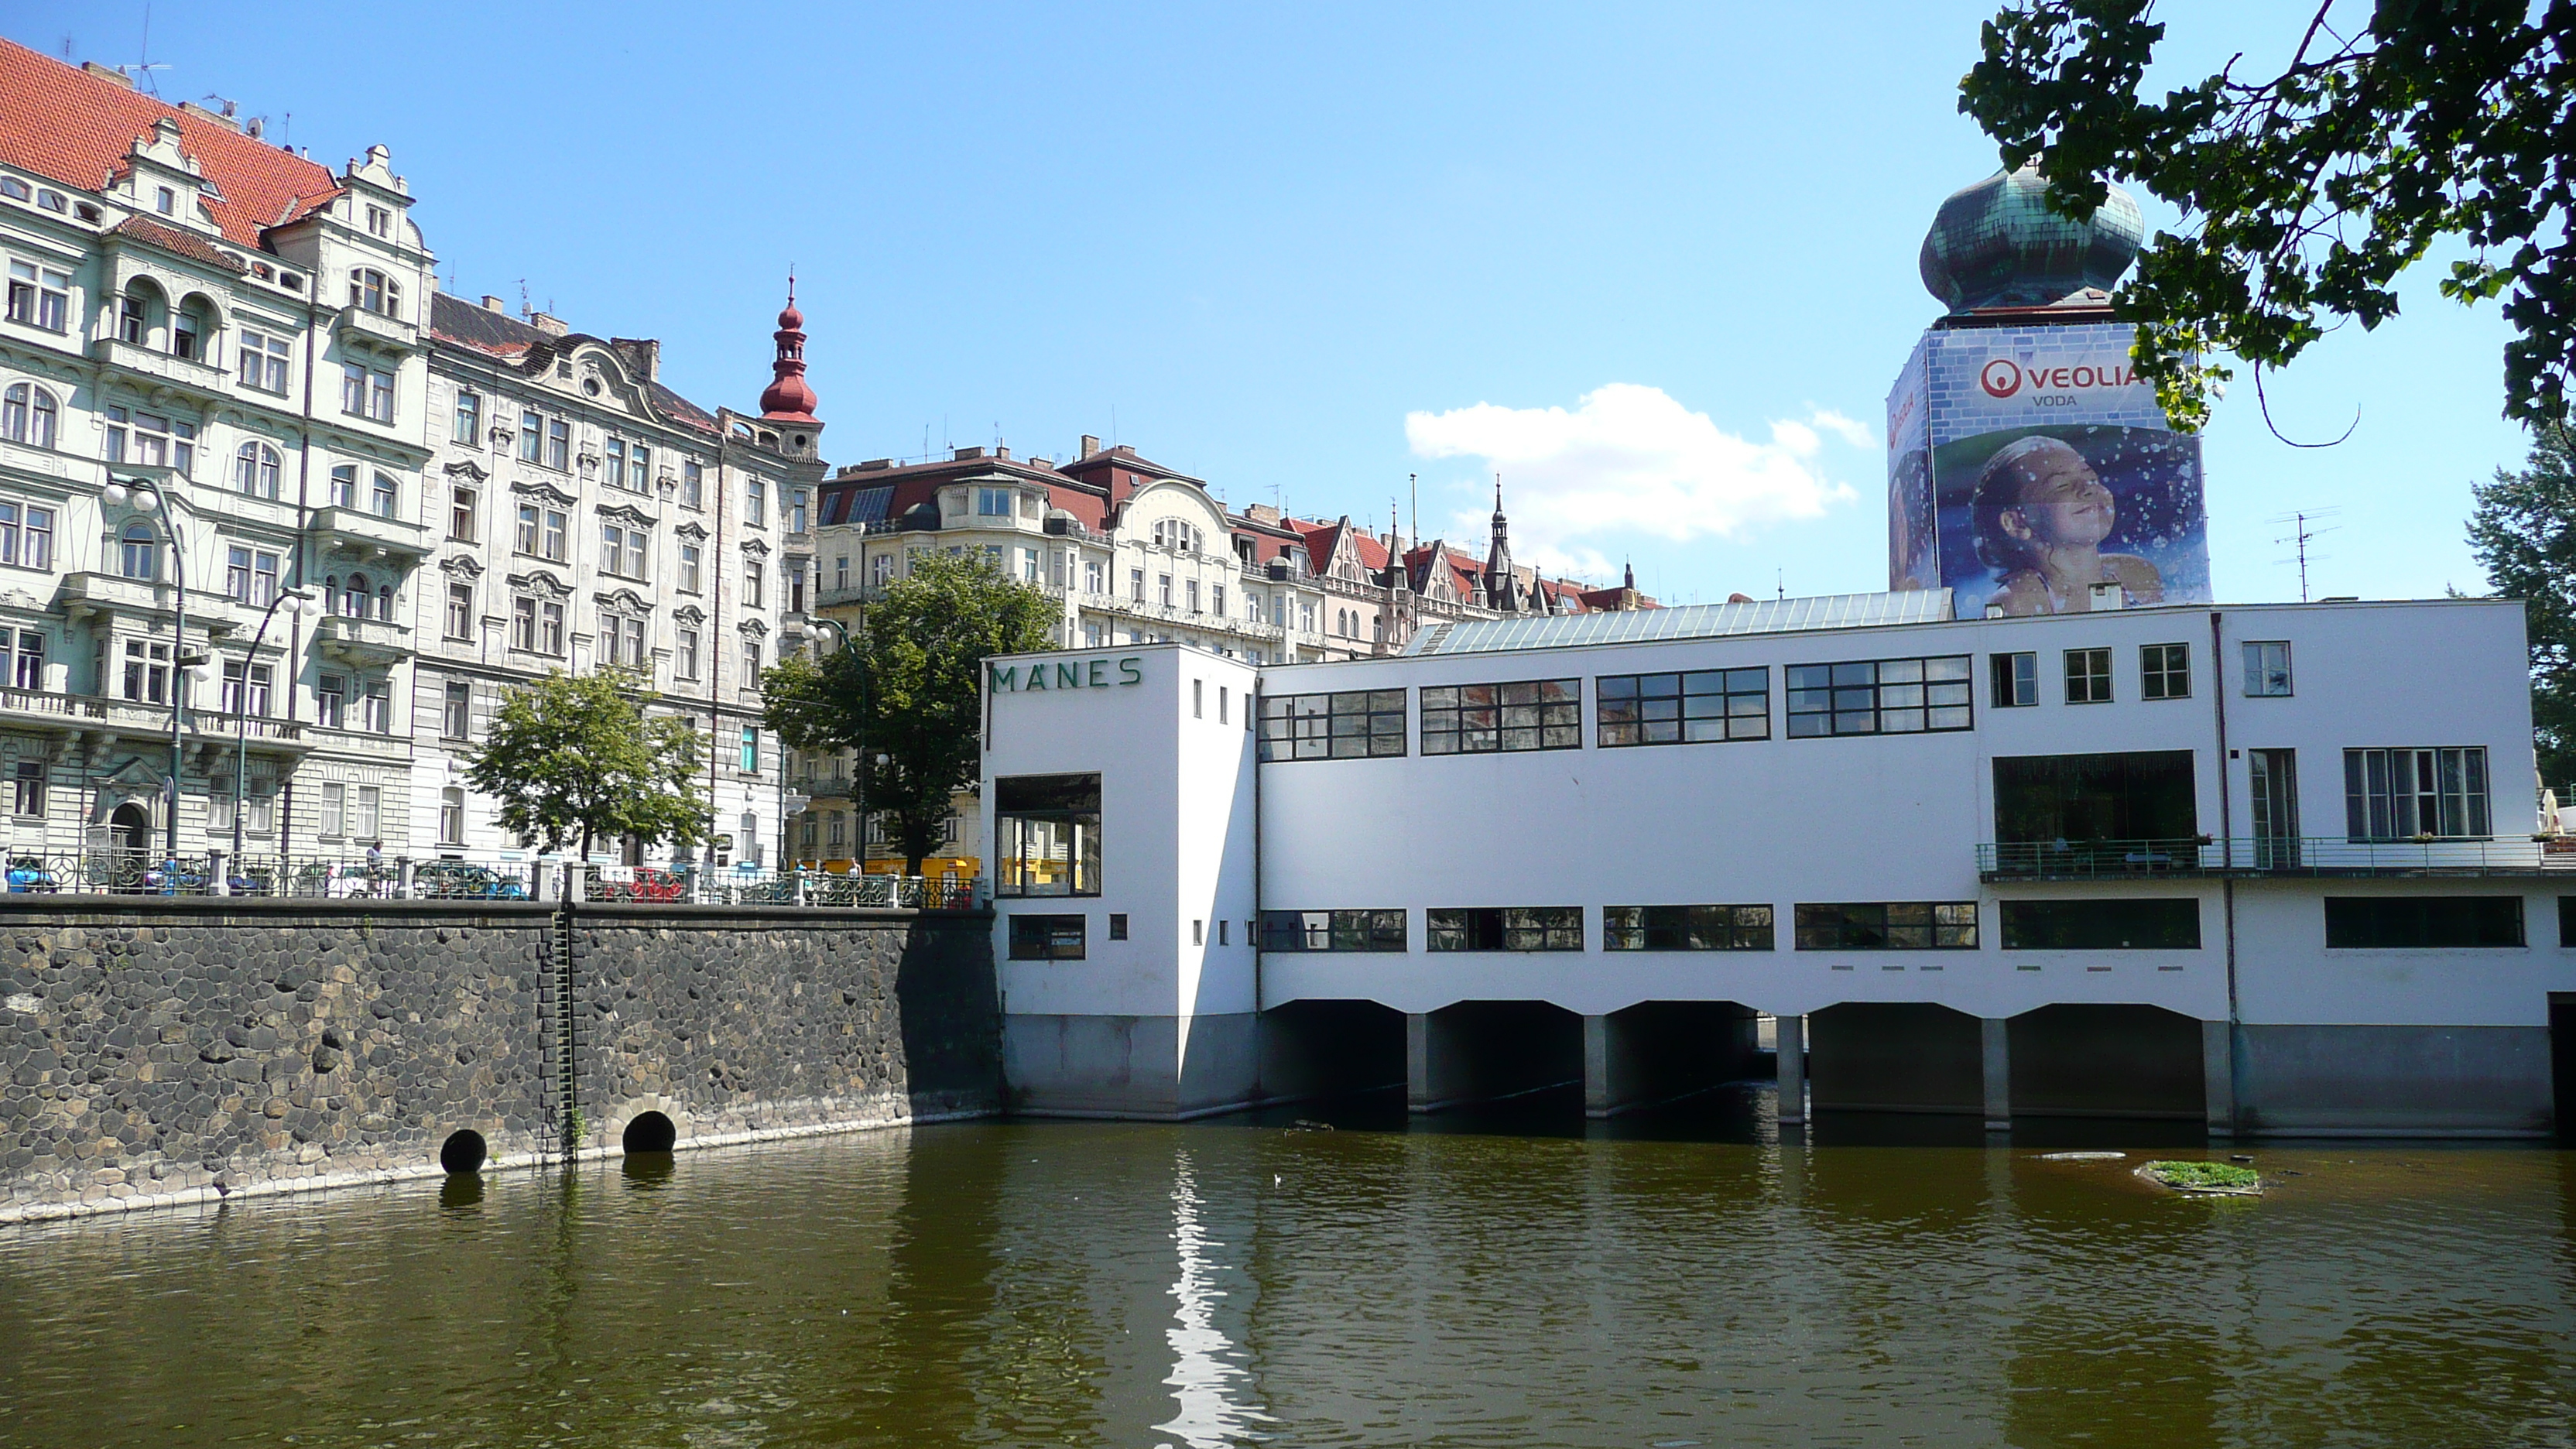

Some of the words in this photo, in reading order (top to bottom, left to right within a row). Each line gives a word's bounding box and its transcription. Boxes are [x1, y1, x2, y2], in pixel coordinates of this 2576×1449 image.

[2027, 365, 2146, 389] VEOLIA
[2032, 395, 2078, 407] VODA
[992, 657, 1142, 694] MÁNES
